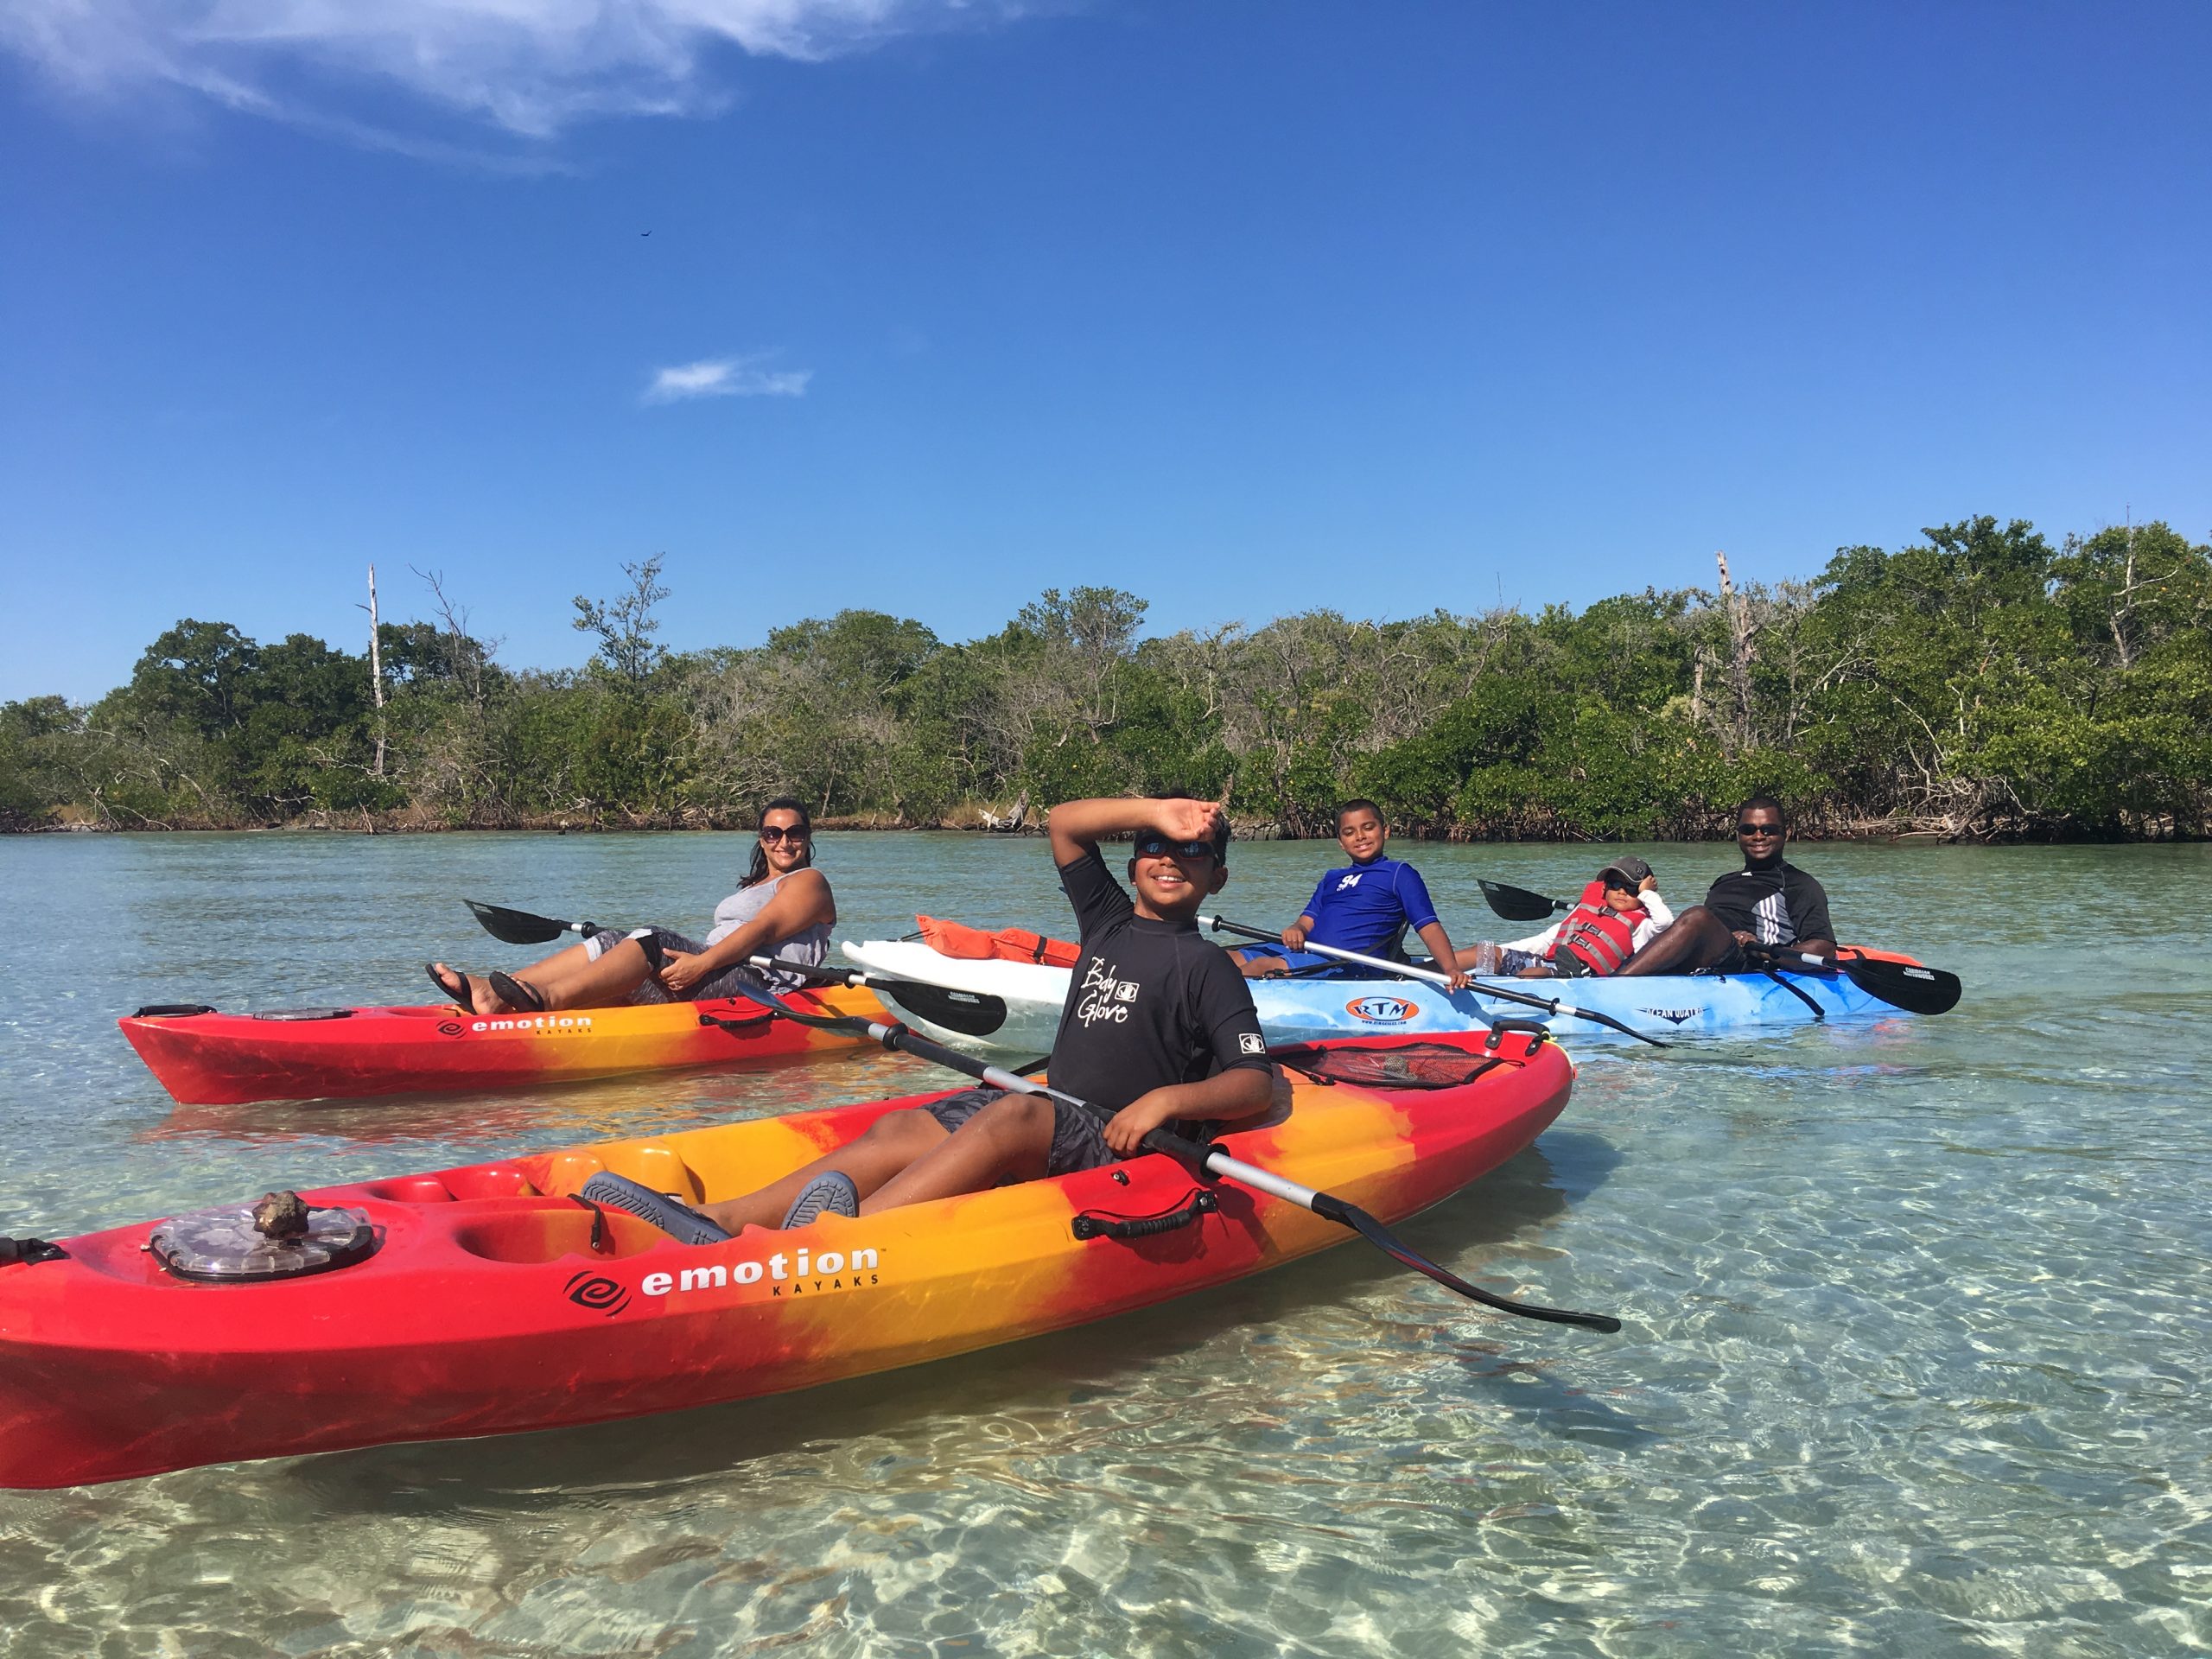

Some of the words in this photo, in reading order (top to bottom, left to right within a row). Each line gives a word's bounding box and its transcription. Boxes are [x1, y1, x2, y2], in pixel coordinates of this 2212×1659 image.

[1338, 874, 1363, 888] 94
[1081, 957, 1117, 1003] Body
[1077, 989, 1128, 1028] Glove
[1353, 1002, 1409, 1016] RTM
[1646, 1007, 1674, 1018] OCEAN
[472, 1015, 592, 1032] emotion
[641, 1248, 879, 1296] emotion
[772, 1274, 879, 1296] KAYAKS
